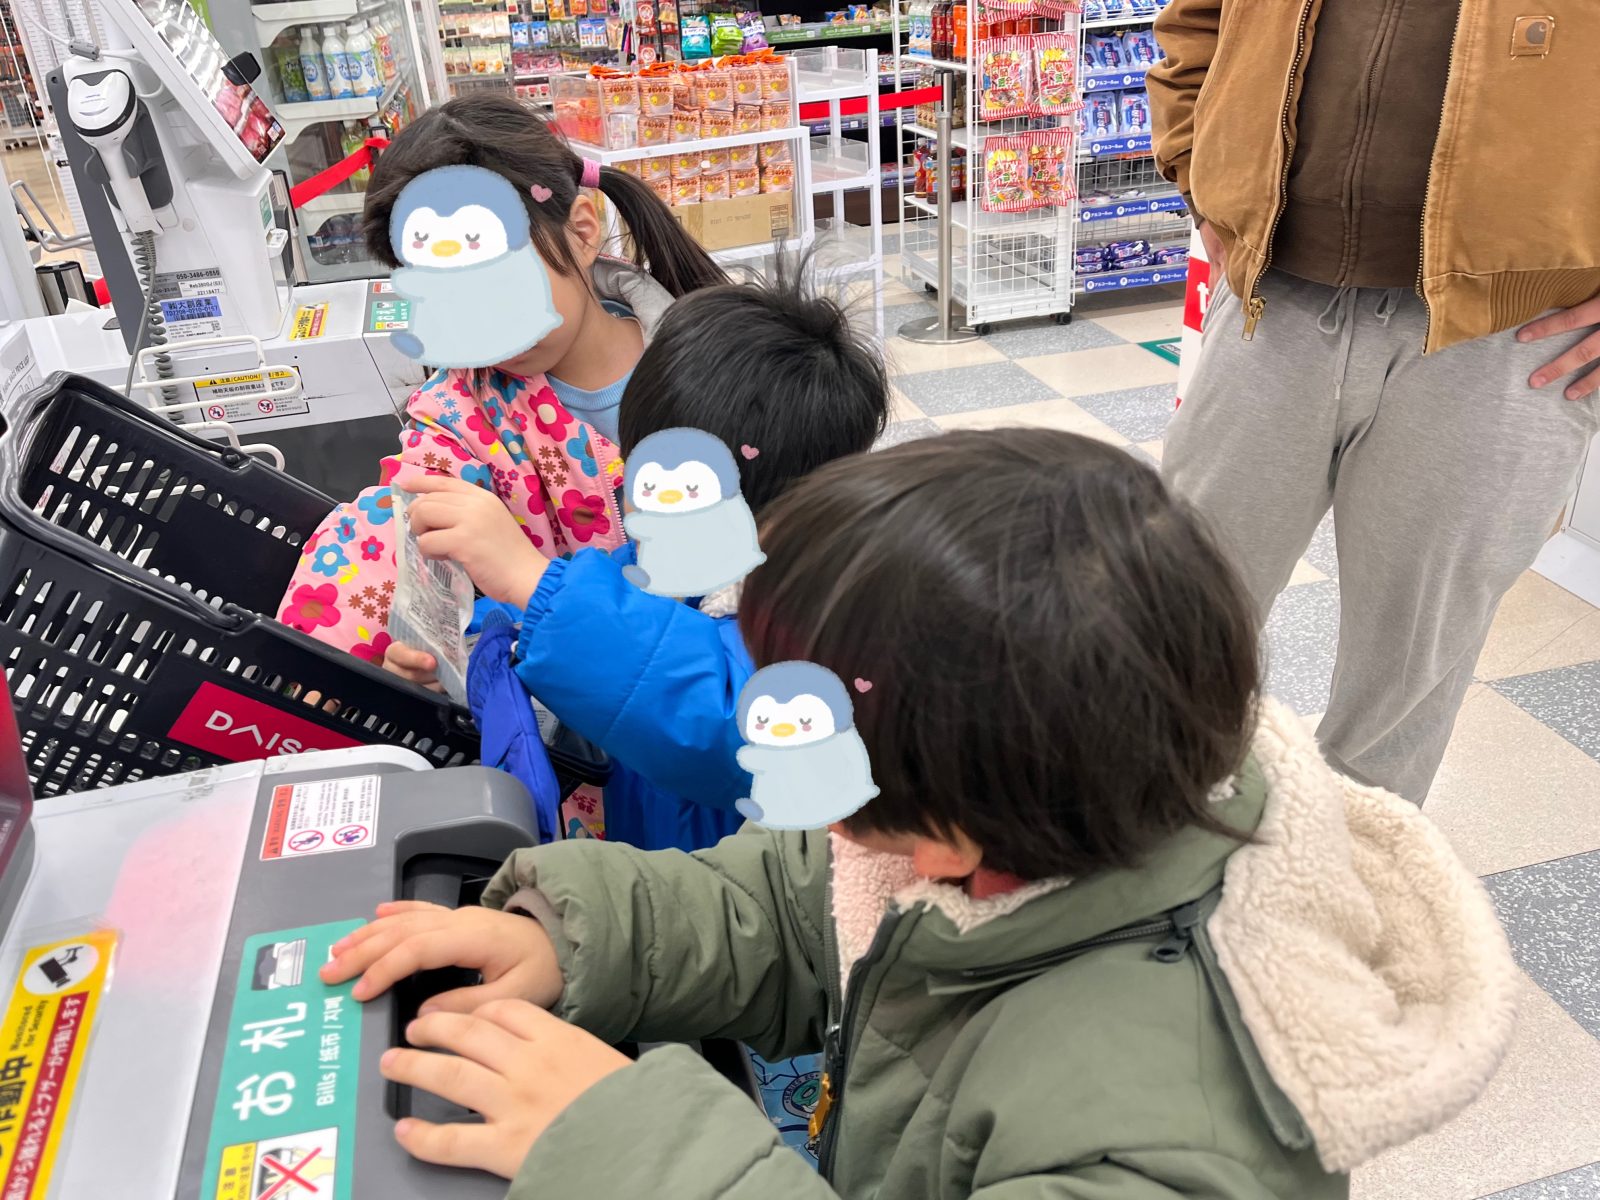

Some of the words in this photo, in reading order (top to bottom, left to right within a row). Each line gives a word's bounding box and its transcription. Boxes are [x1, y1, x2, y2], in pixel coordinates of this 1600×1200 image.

[204, 709, 322, 756] DAIS
[9, 1005, 33, 1051] Monitored
[28, 999, 49, 1033] Security
[231, 1001, 307, 1121] お札
[316, 1071, 337, 1107] Bills
